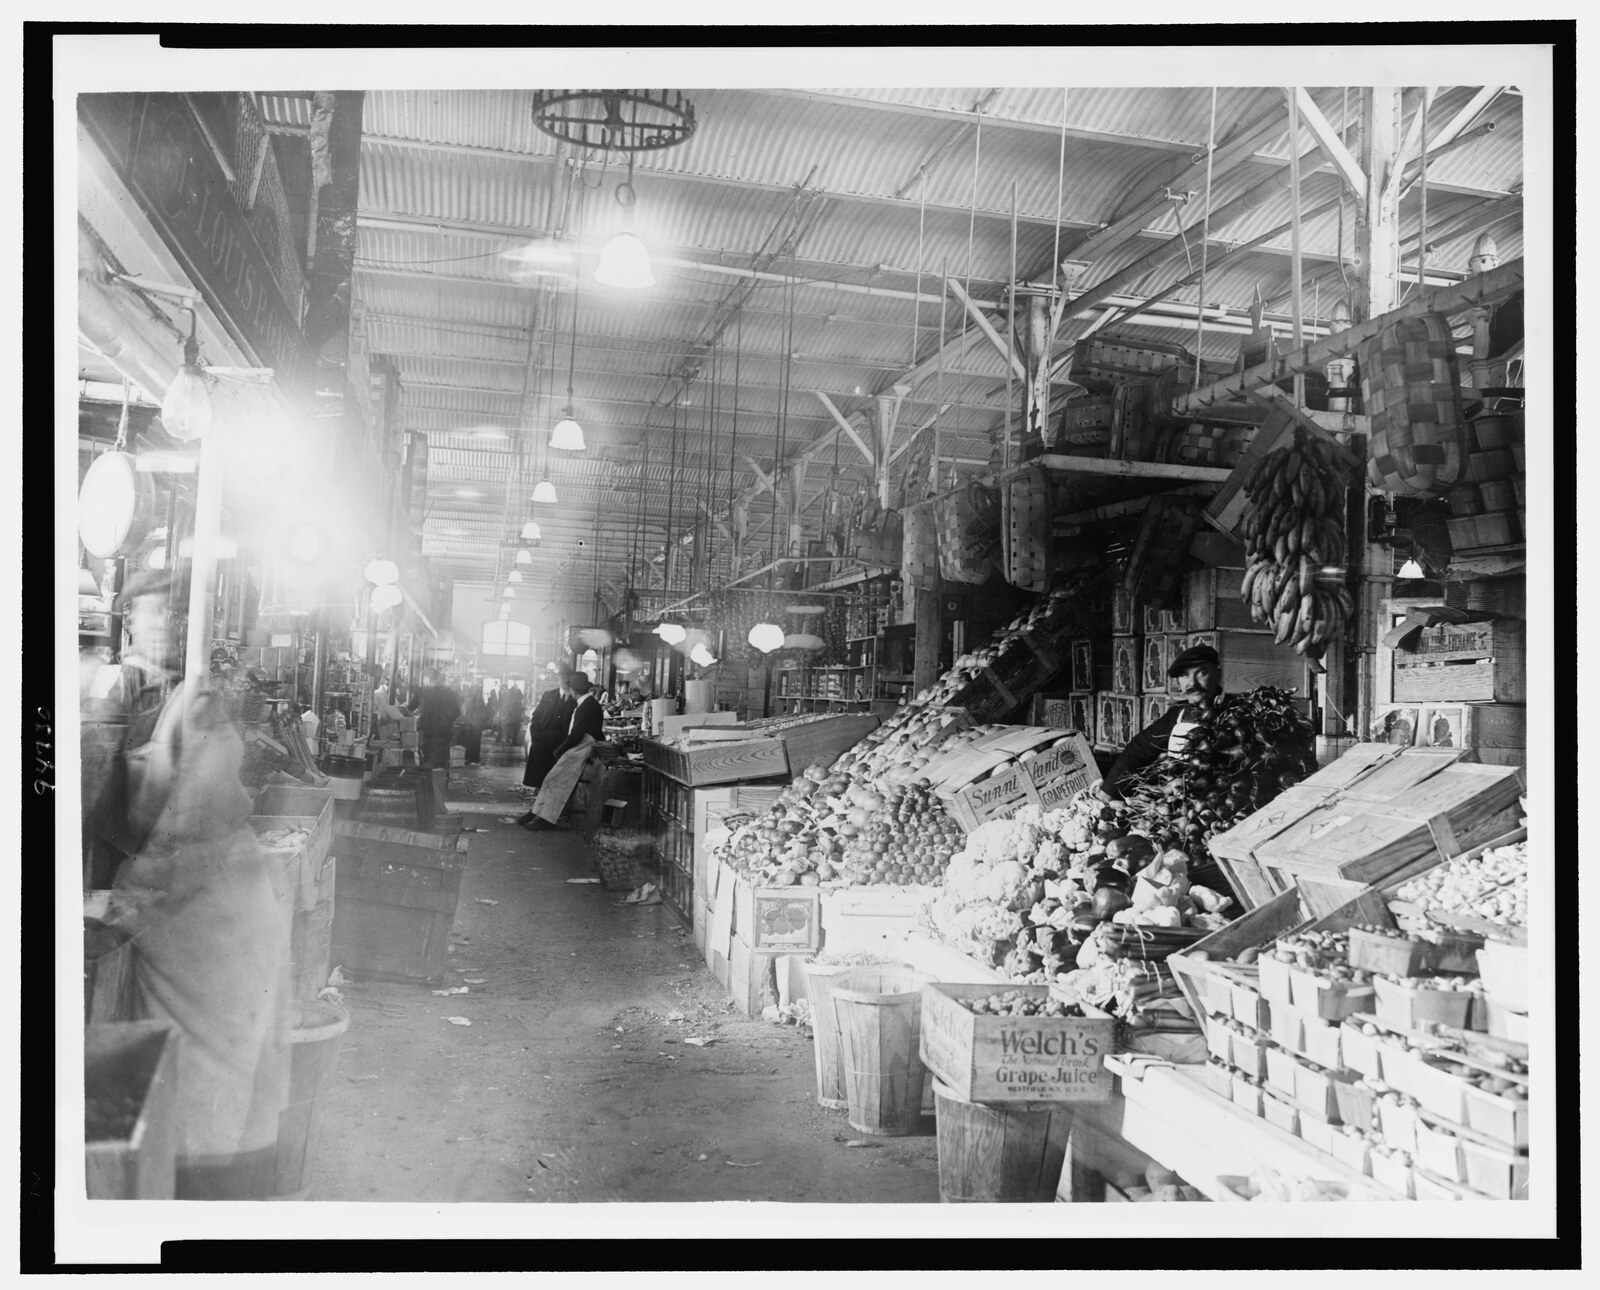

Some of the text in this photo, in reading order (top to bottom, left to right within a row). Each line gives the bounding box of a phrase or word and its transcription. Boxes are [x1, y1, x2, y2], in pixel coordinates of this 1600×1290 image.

[194, 184, 256, 311] LOUIS
[972, 775, 1018, 810] Sunni
[1043, 773, 1090, 806] GRAPEFRUIT
[1000, 1030, 1099, 1056] Welch's
[996, 1067, 1098, 1085] Grape Juice
[1061, 1056, 1091, 1068] Drink
